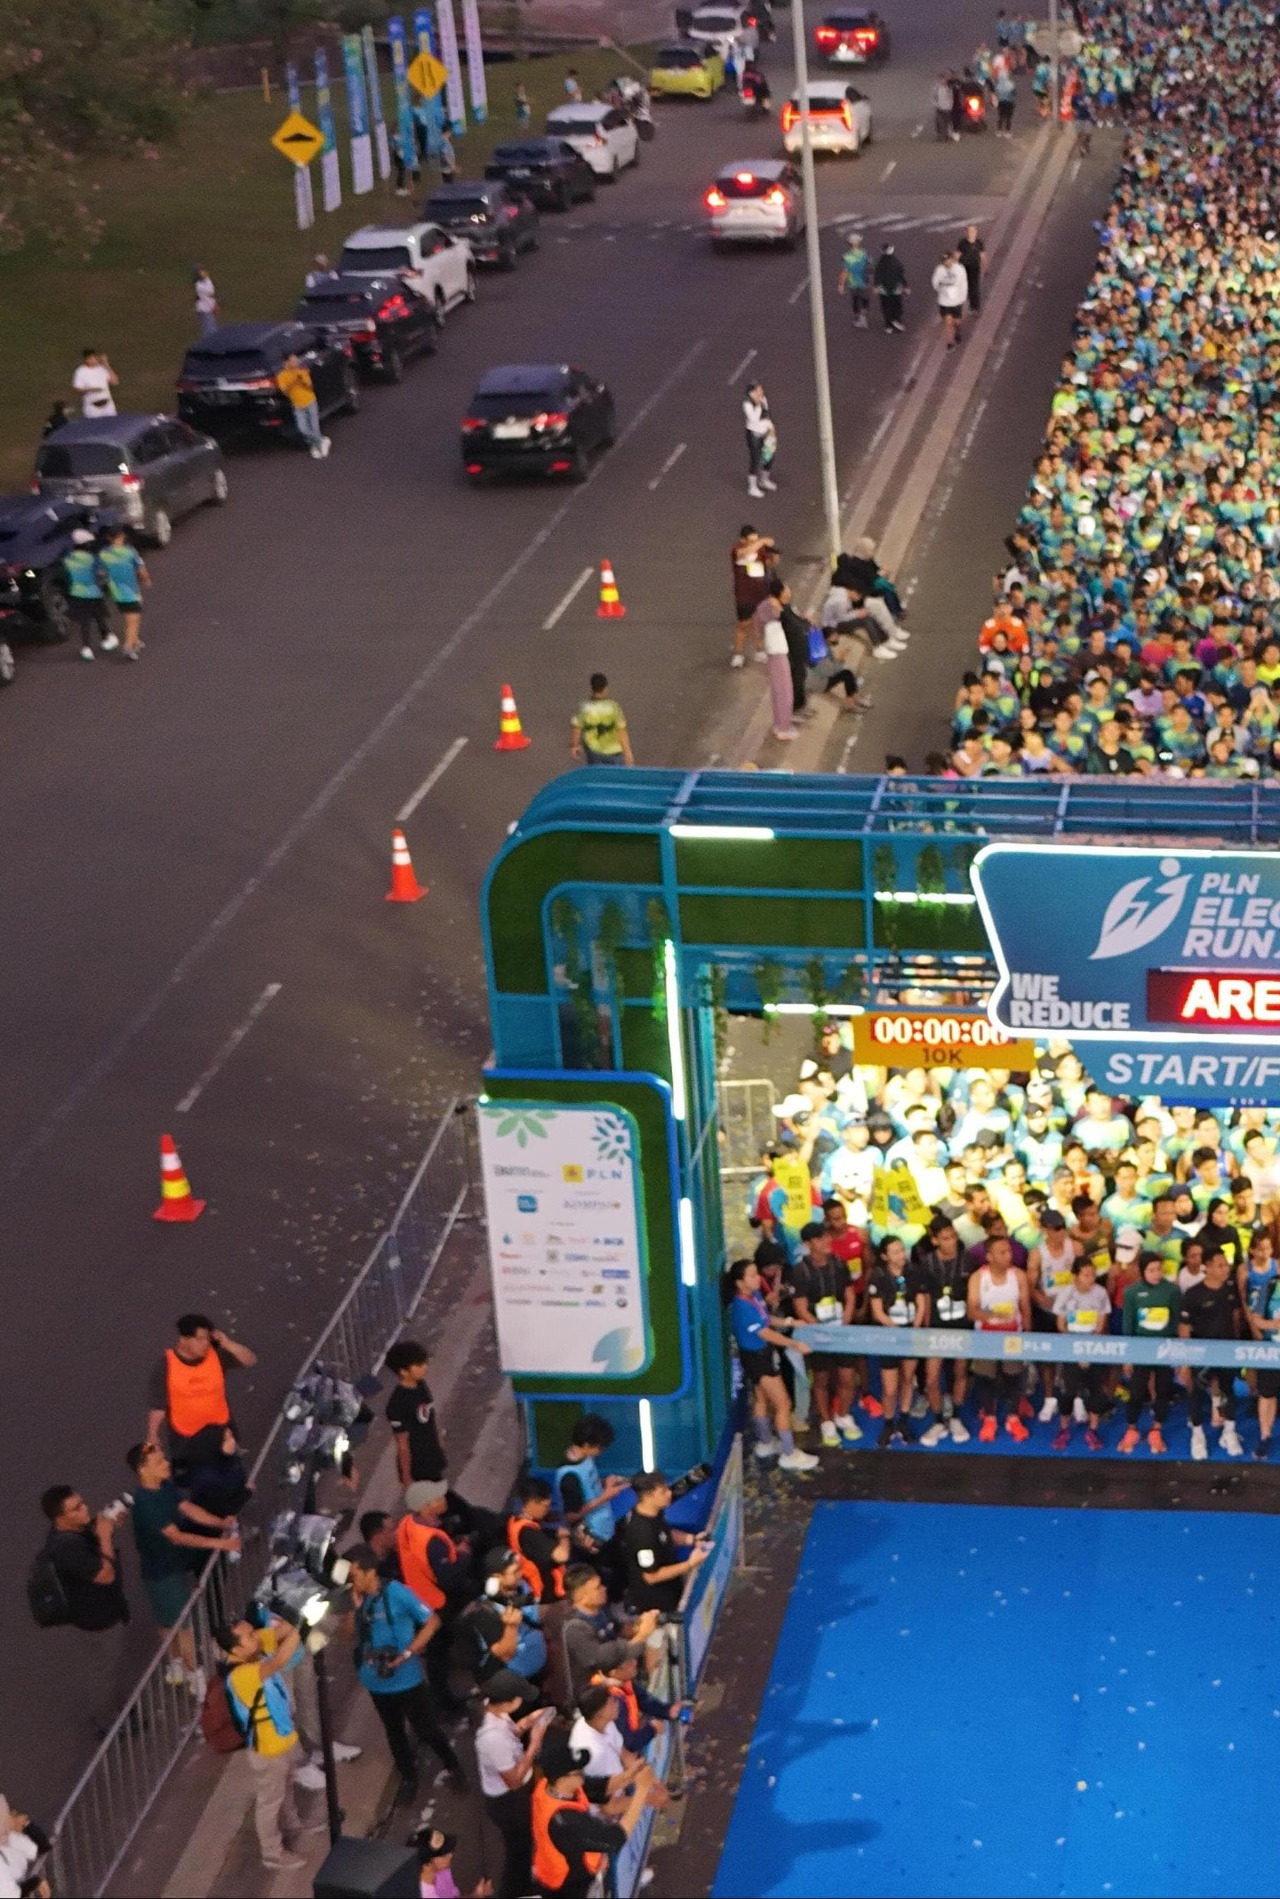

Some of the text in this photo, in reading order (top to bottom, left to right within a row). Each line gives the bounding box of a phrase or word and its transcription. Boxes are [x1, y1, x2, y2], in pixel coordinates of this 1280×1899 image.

[1200, 873, 1260, 895] PLN
[1012, 972, 1060, 1000] WE
[1010, 1000, 1131, 1029] REDUCE
[923, 1048, 963, 1064] 10K
[927, 1334, 964, 1351] 10K
[1072, 1340, 1128, 1357] START
